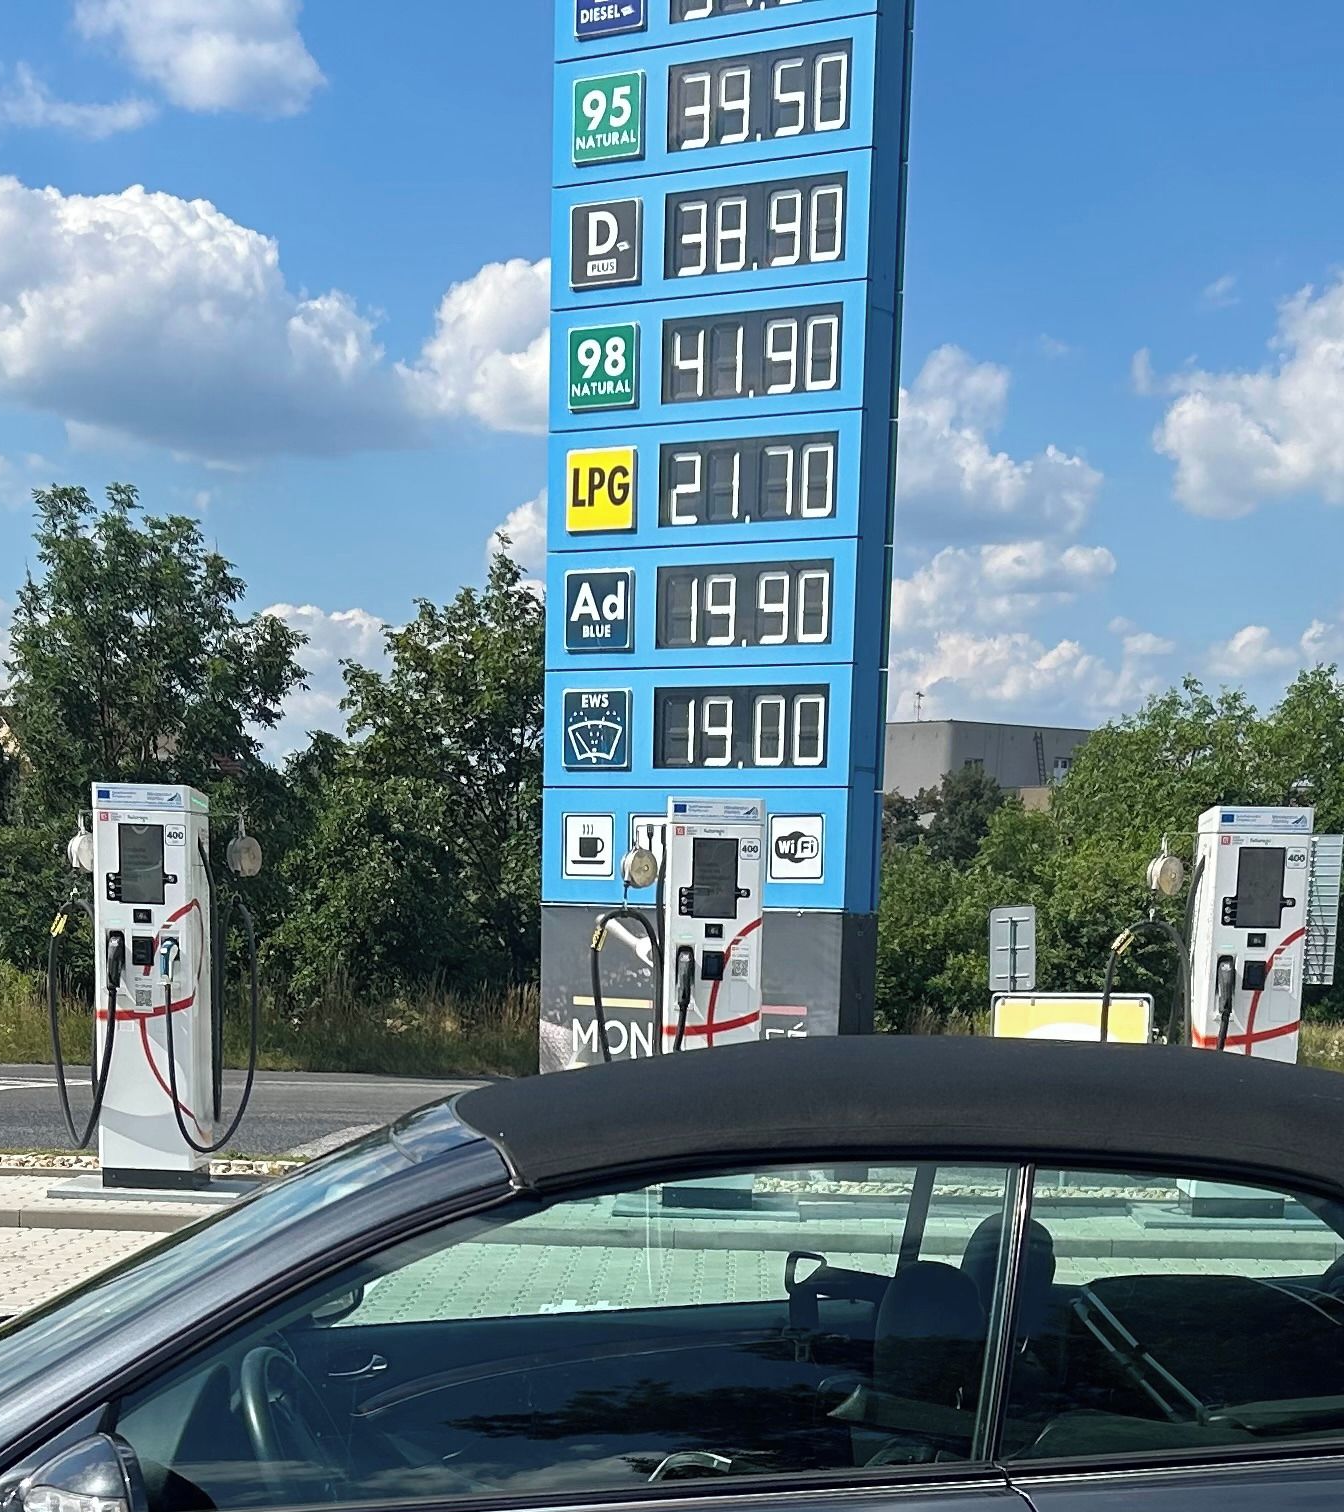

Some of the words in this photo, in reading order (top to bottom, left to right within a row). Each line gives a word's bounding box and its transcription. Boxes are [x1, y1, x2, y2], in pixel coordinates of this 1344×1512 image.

[580, 9, 620, 24] DIESEL
[582, 85, 632, 130] 95
[575, 131, 637, 151] NATURAL
[591, 261, 615, 273] PLUS
[577, 336, 627, 379] 98
[571, 379, 631, 398] NATURAL
[571, 465, 630, 508] LPG
[570, 582, 625, 622] Ad
[582, 624, 611, 639] BLUE
[581, 694, 609, 709] EWS
[167, 831, 184, 840] 400
[741, 845, 759, 853] 400
[1287, 854, 1305, 862] 400
